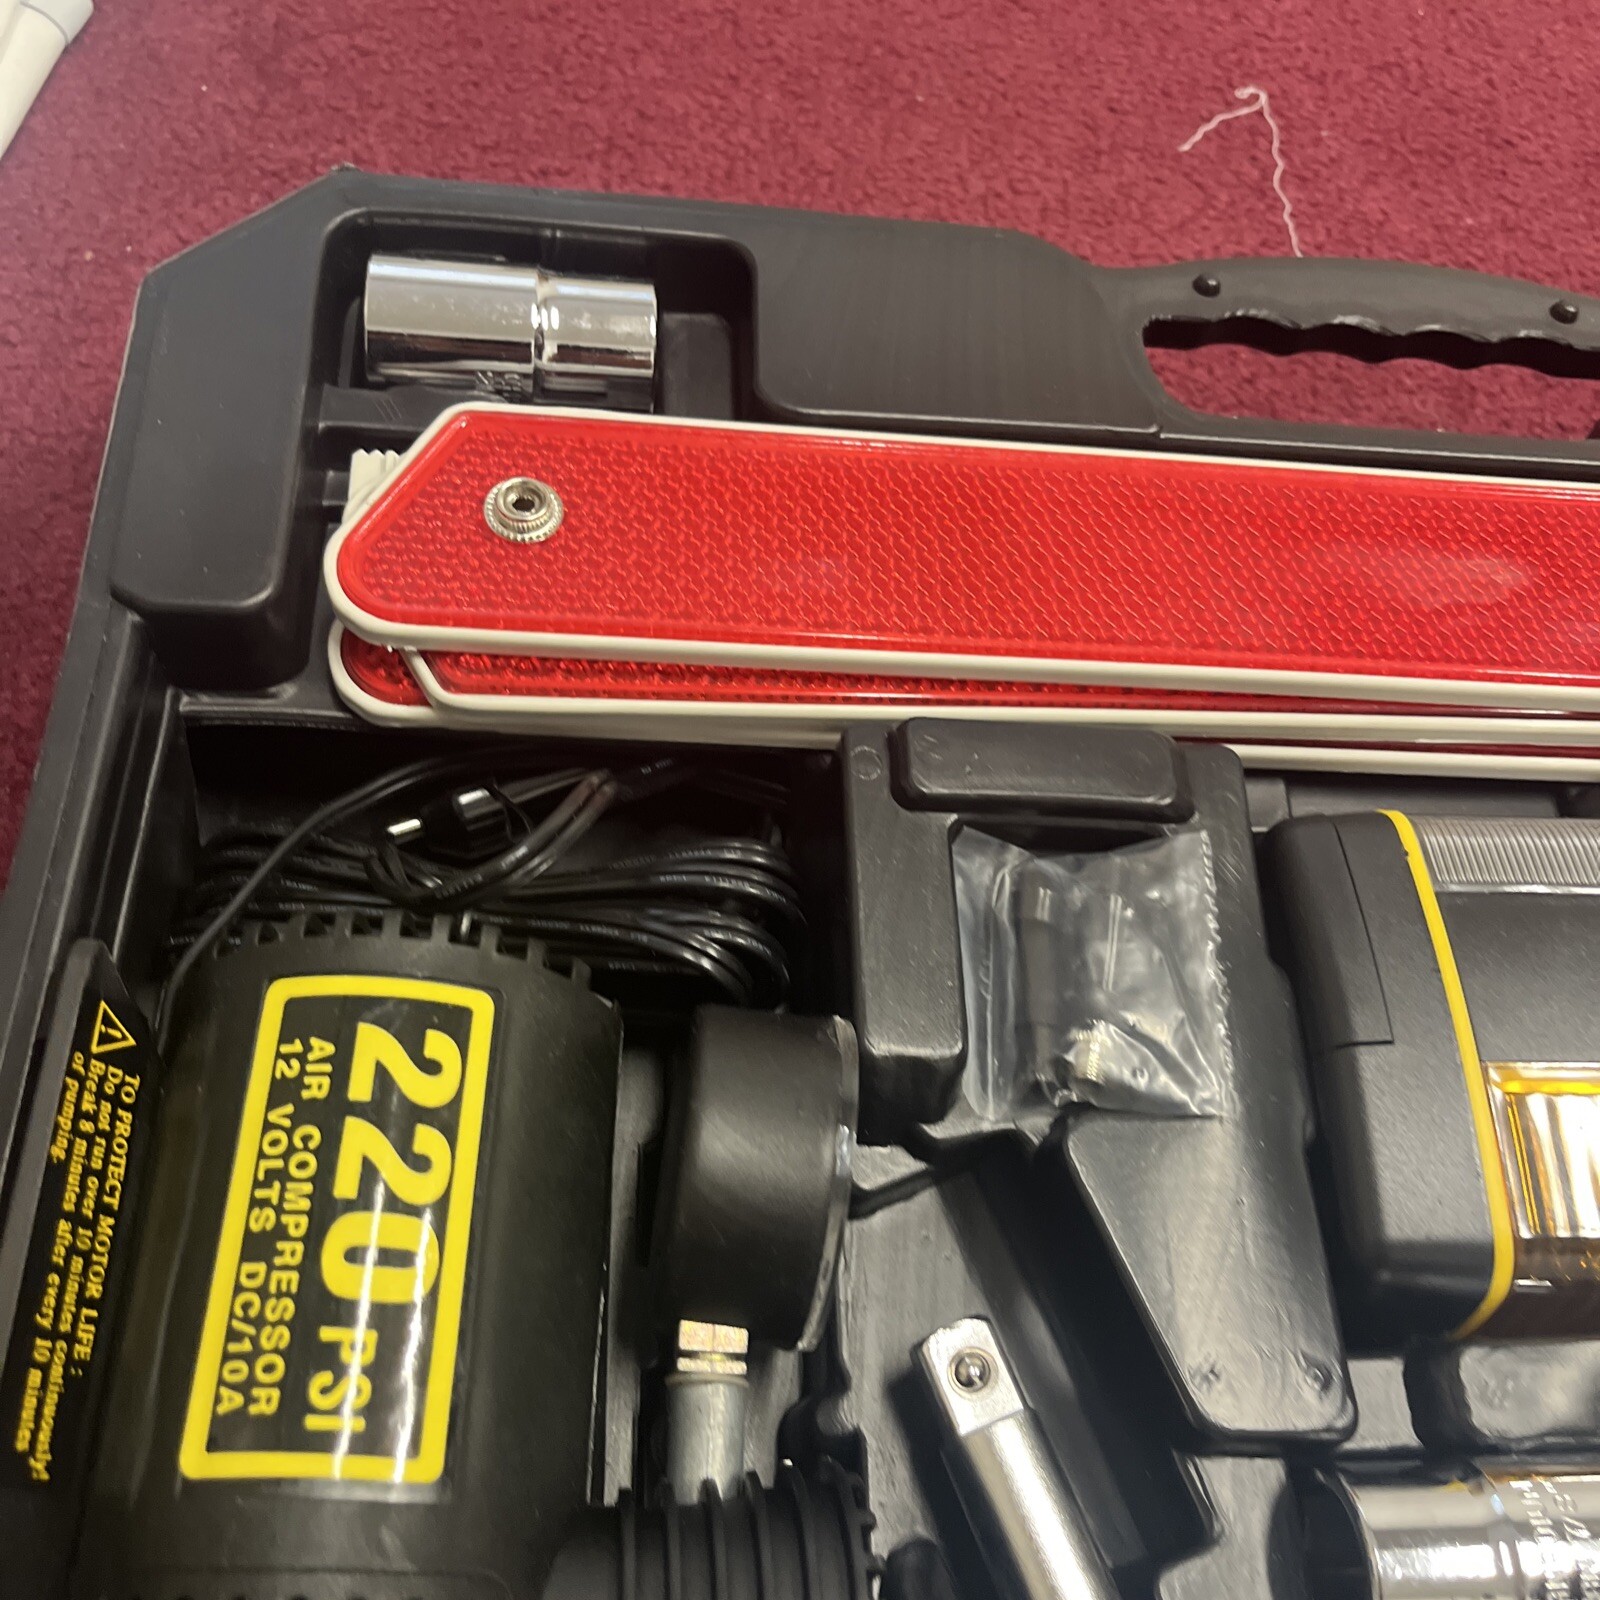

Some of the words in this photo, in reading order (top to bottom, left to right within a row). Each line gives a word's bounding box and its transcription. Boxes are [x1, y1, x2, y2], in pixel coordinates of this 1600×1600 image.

[72, 1052, 85, 1076] of
[81, 1058, 105, 1114] Break
[103, 1065, 123, 1095] Do
[275, 1037, 302, 1080] 12
[300, 1036, 336, 1100] AIR
[94, 1100, 111, 1131] not
[121, 1073, 140, 1104] TO
[79, 1119, 95, 1133] 8
[90, 1136, 106, 1170] run
[63, 1137, 88, 1212] minutes
[103, 1108, 132, 1210] PROTECT
[248, 1104, 295, 1234] VOLTS
[320, 1022, 463, 1303] 220
[82, 1176, 99, 1219] over
[52, 1219, 73, 1266] after
[76, 1226, 93, 1250] 10
[85, 1214, 115, 1299] MOTOR
[59, 1255, 84, 1335] minutes
[247, 1124, 321, 1417] COMPRESSOR
[35, 1273, 60, 1330] every
[33, 1337, 54, 1363] 10
[73, 1307, 98, 1360] LIFE
[216, 1261, 266, 1416] DC/10A
[303, 1325, 379, 1434] PSI
[15, 1368, 42, 1452] minutes
